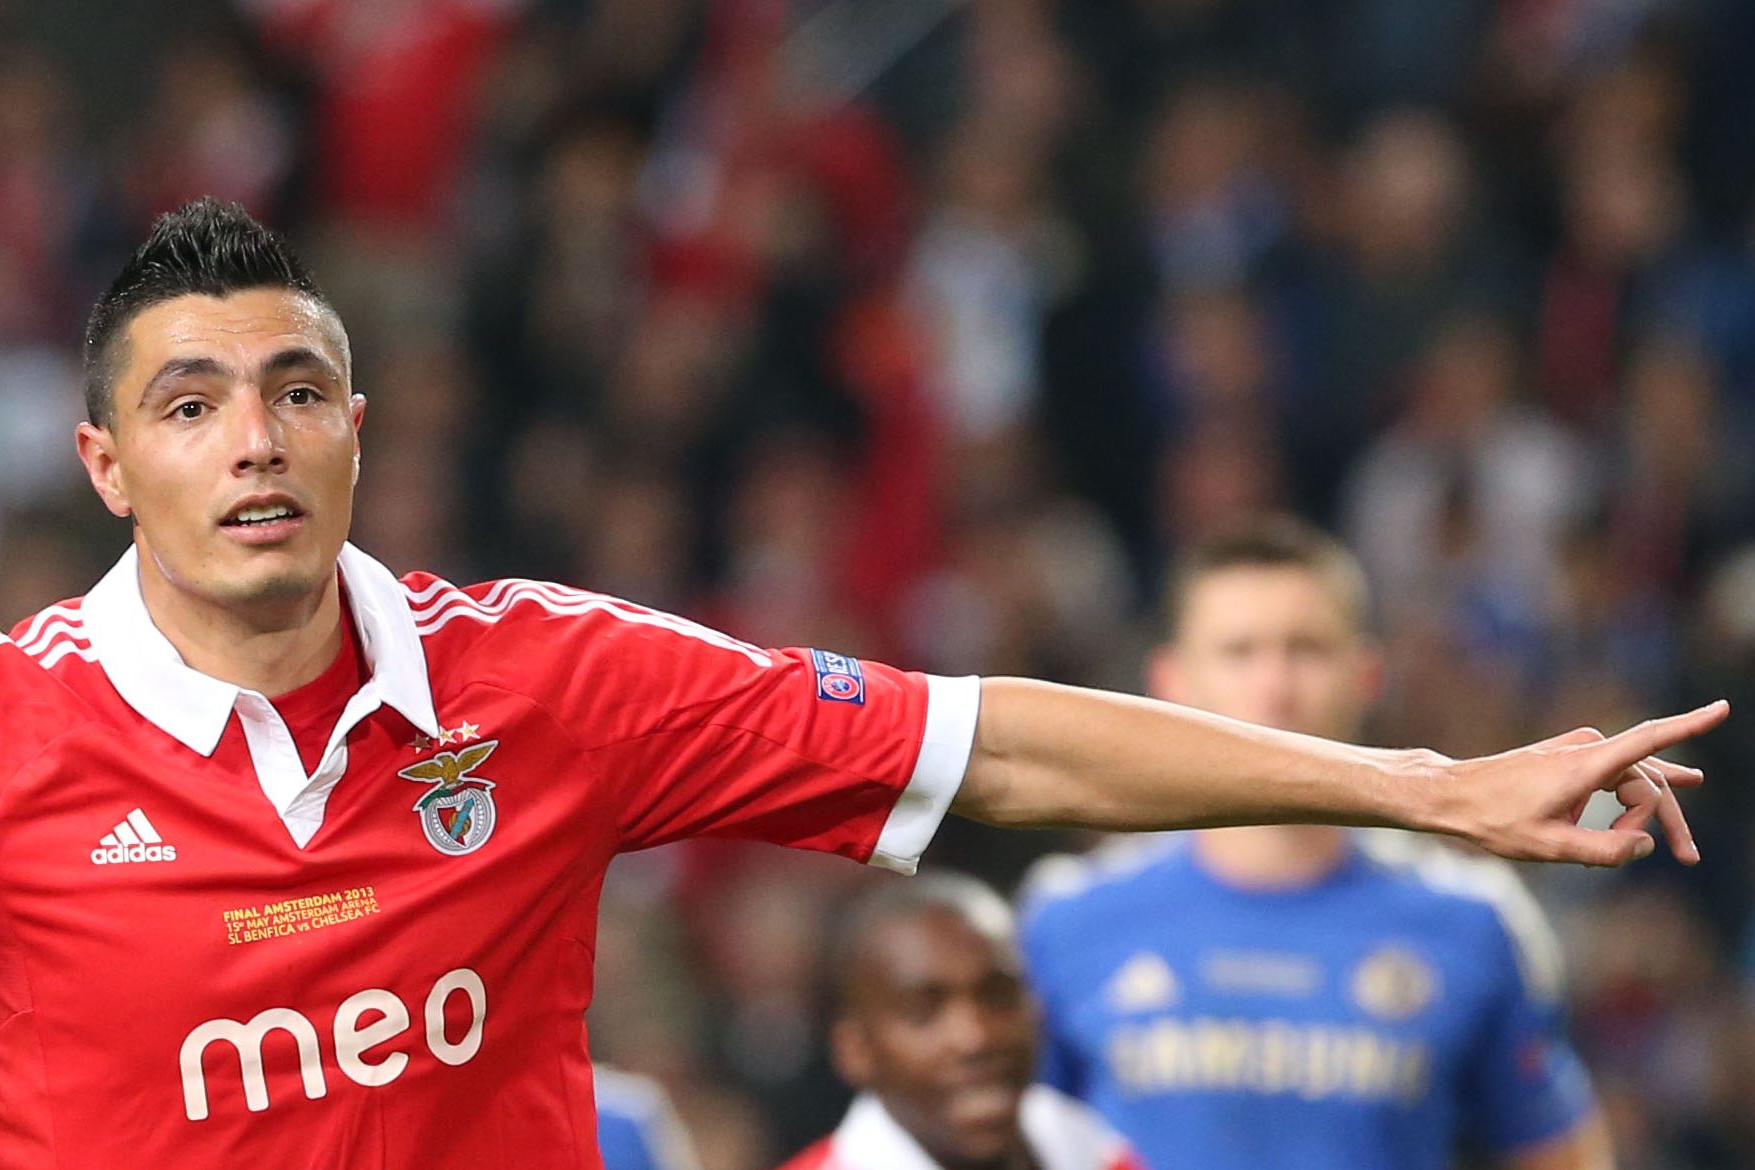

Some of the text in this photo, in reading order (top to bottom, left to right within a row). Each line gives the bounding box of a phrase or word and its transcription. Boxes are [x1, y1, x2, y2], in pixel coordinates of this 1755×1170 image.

[90, 842, 177, 865] adidas
[223, 886, 374, 922] FINAL AMSTERDAM 2013
[247, 917, 271, 929] MAY
[273, 905, 339, 924] AMSTERDAM
[341, 897, 377, 911] ARENA
[228, 903, 380, 945] SL BENFICA vs CHELSEA FC
[179, 968, 487, 1121] meo
